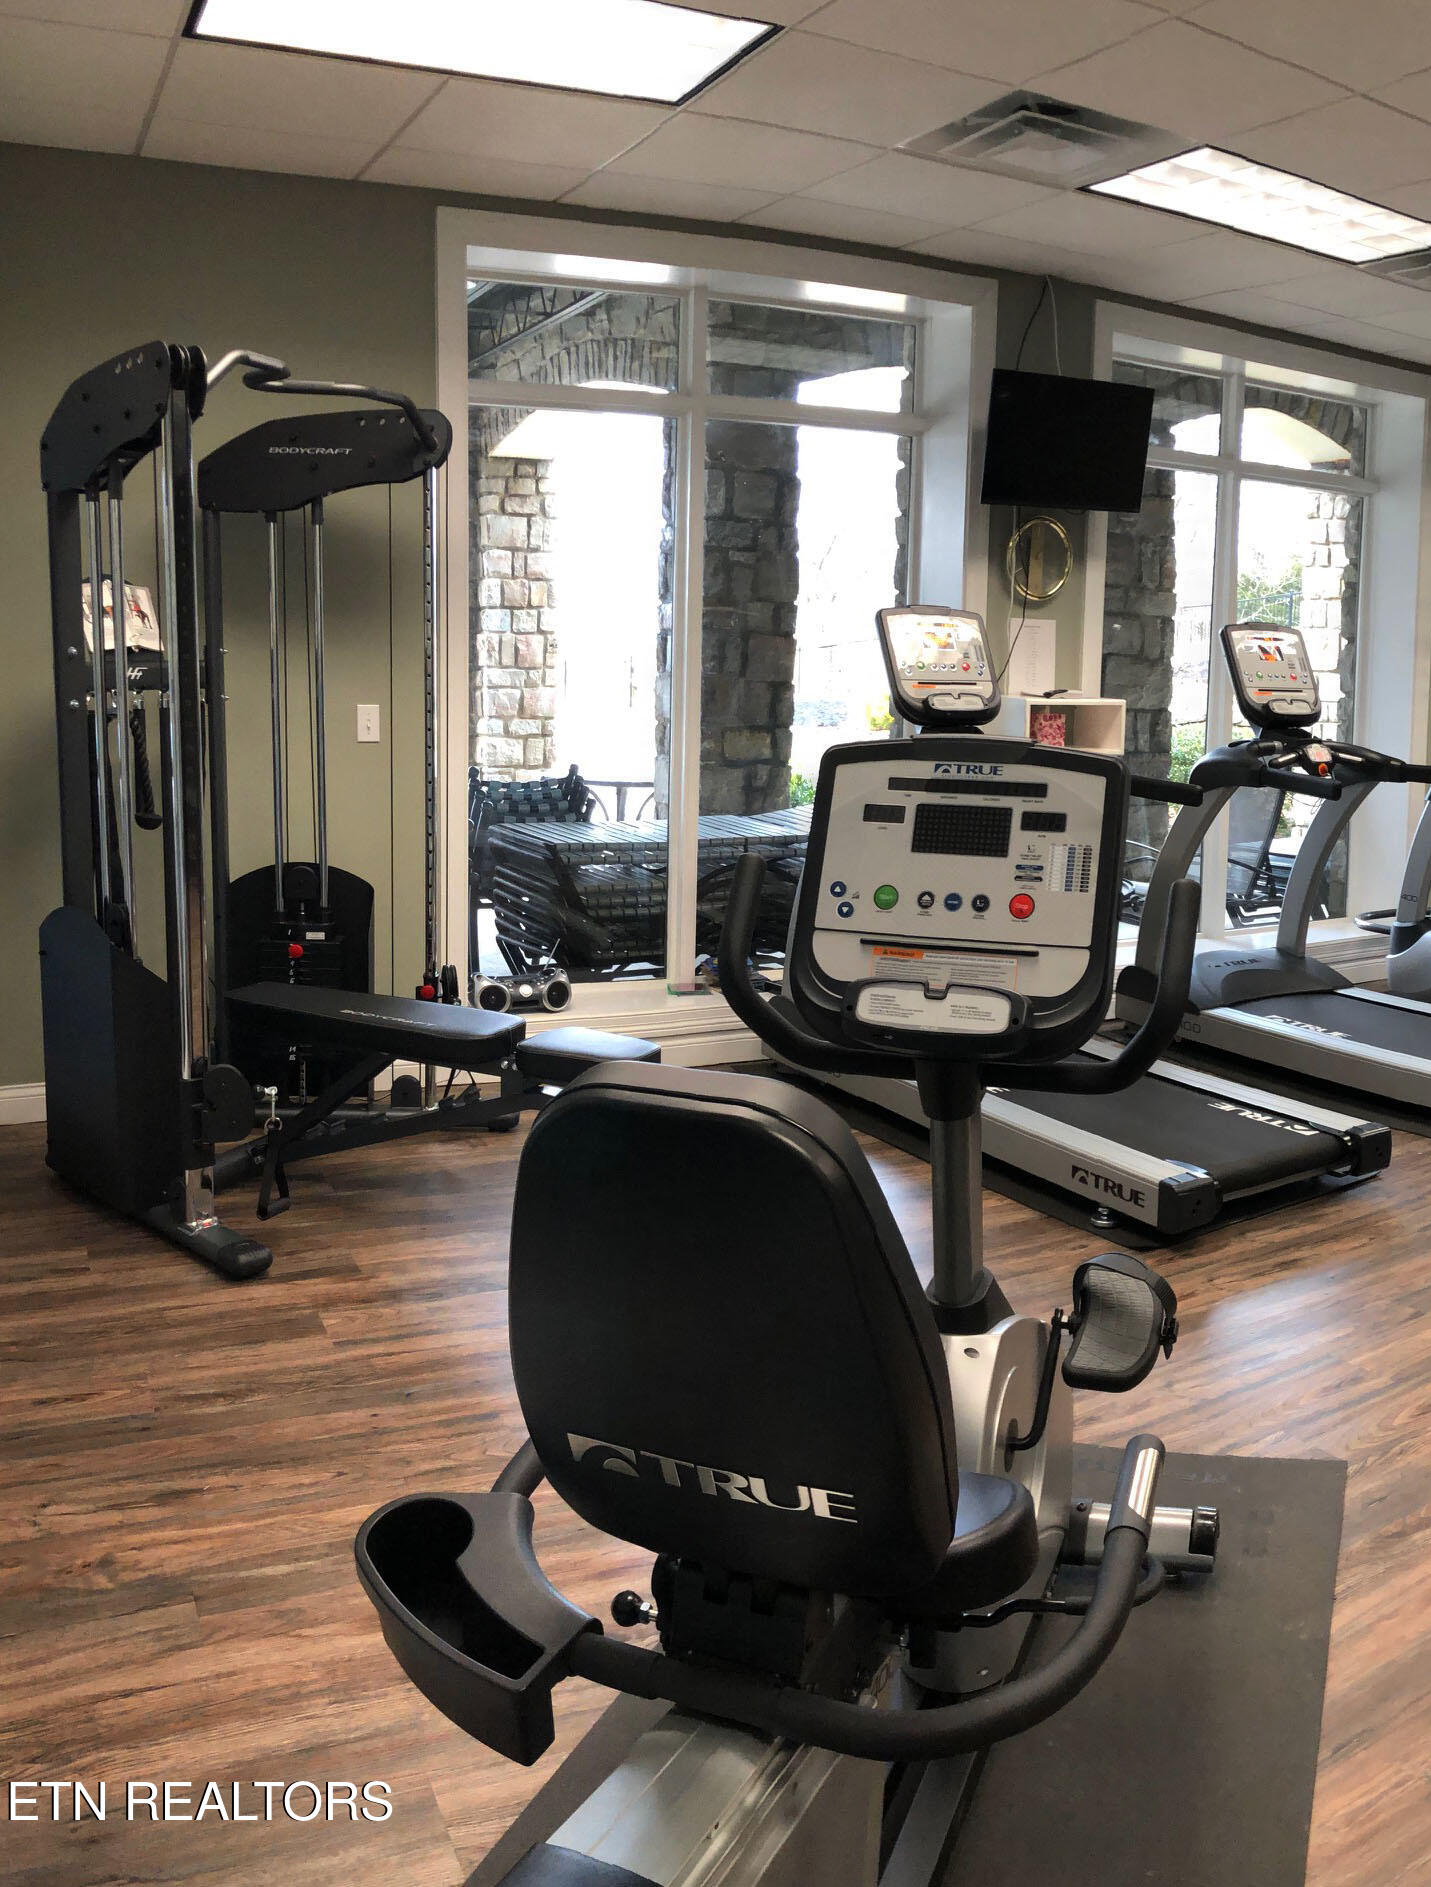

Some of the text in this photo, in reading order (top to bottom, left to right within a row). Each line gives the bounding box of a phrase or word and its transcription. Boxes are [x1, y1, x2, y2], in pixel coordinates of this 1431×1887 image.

[268, 446, 353, 456] BODYCRAFT
[953, 763, 1005, 776] TRUE
[1207, 1102, 1285, 1128] TRUE
[1090, 1172, 1146, 1208] TRUE
[639, 1450, 858, 1524] TRUE
